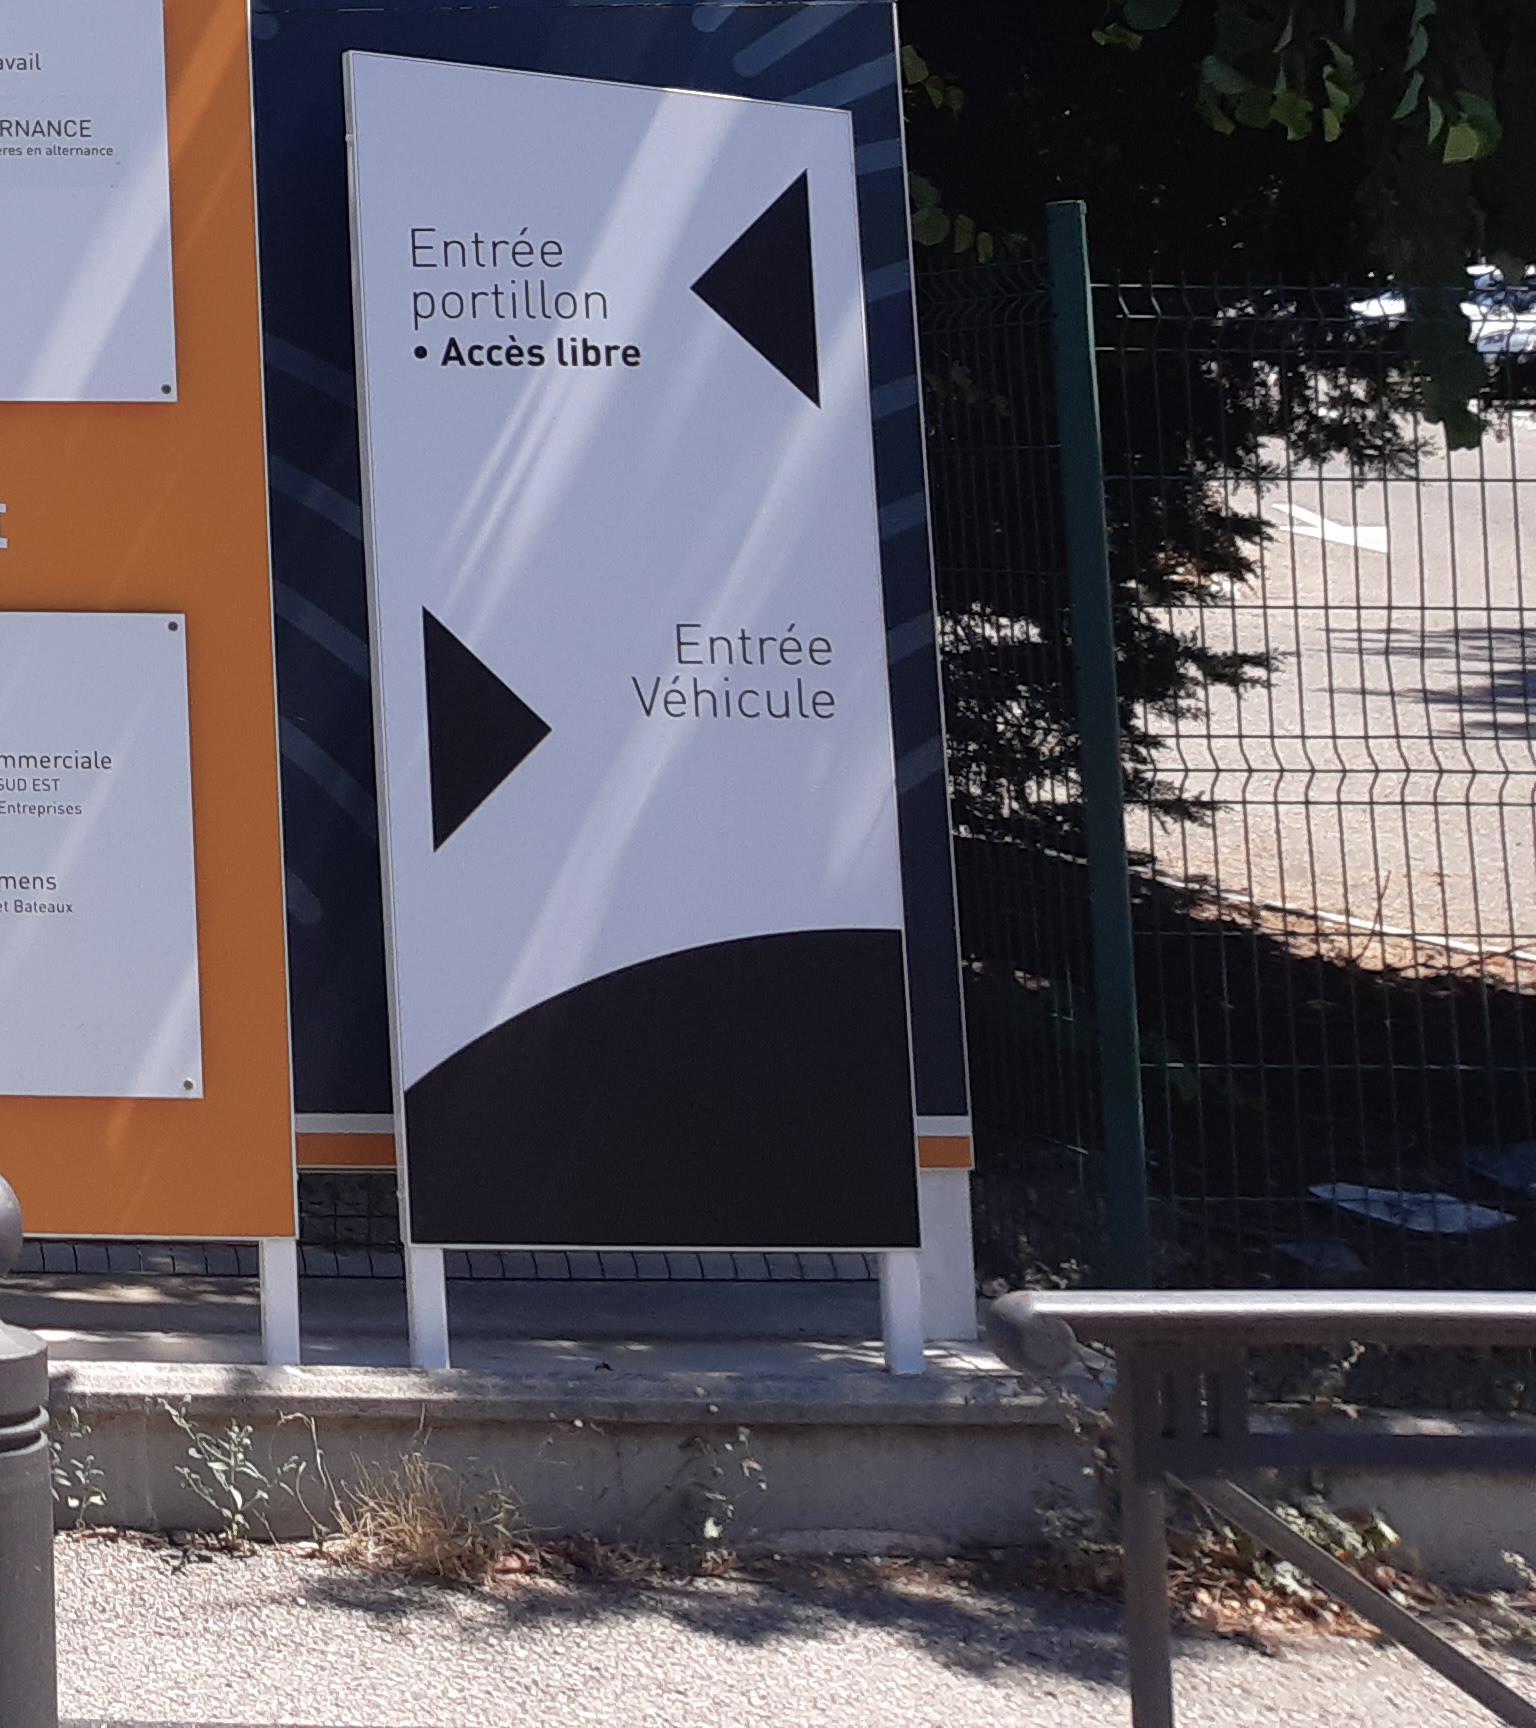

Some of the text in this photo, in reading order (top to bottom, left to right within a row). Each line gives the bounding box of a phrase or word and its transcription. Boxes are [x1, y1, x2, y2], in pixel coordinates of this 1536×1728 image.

[26, 146, 42, 156] en
[45, 144, 113, 157] alternance
[409, 226, 565, 269] Entrée
[411, 280, 609, 331] portillon
[440, 334, 642, 369] Accès libre
[675, 622, 833, 667] Entrée
[631, 675, 836, 720] Véhicule
[32, 778, 60, 792] EST
[14, 899, 73, 913] Bateaux
